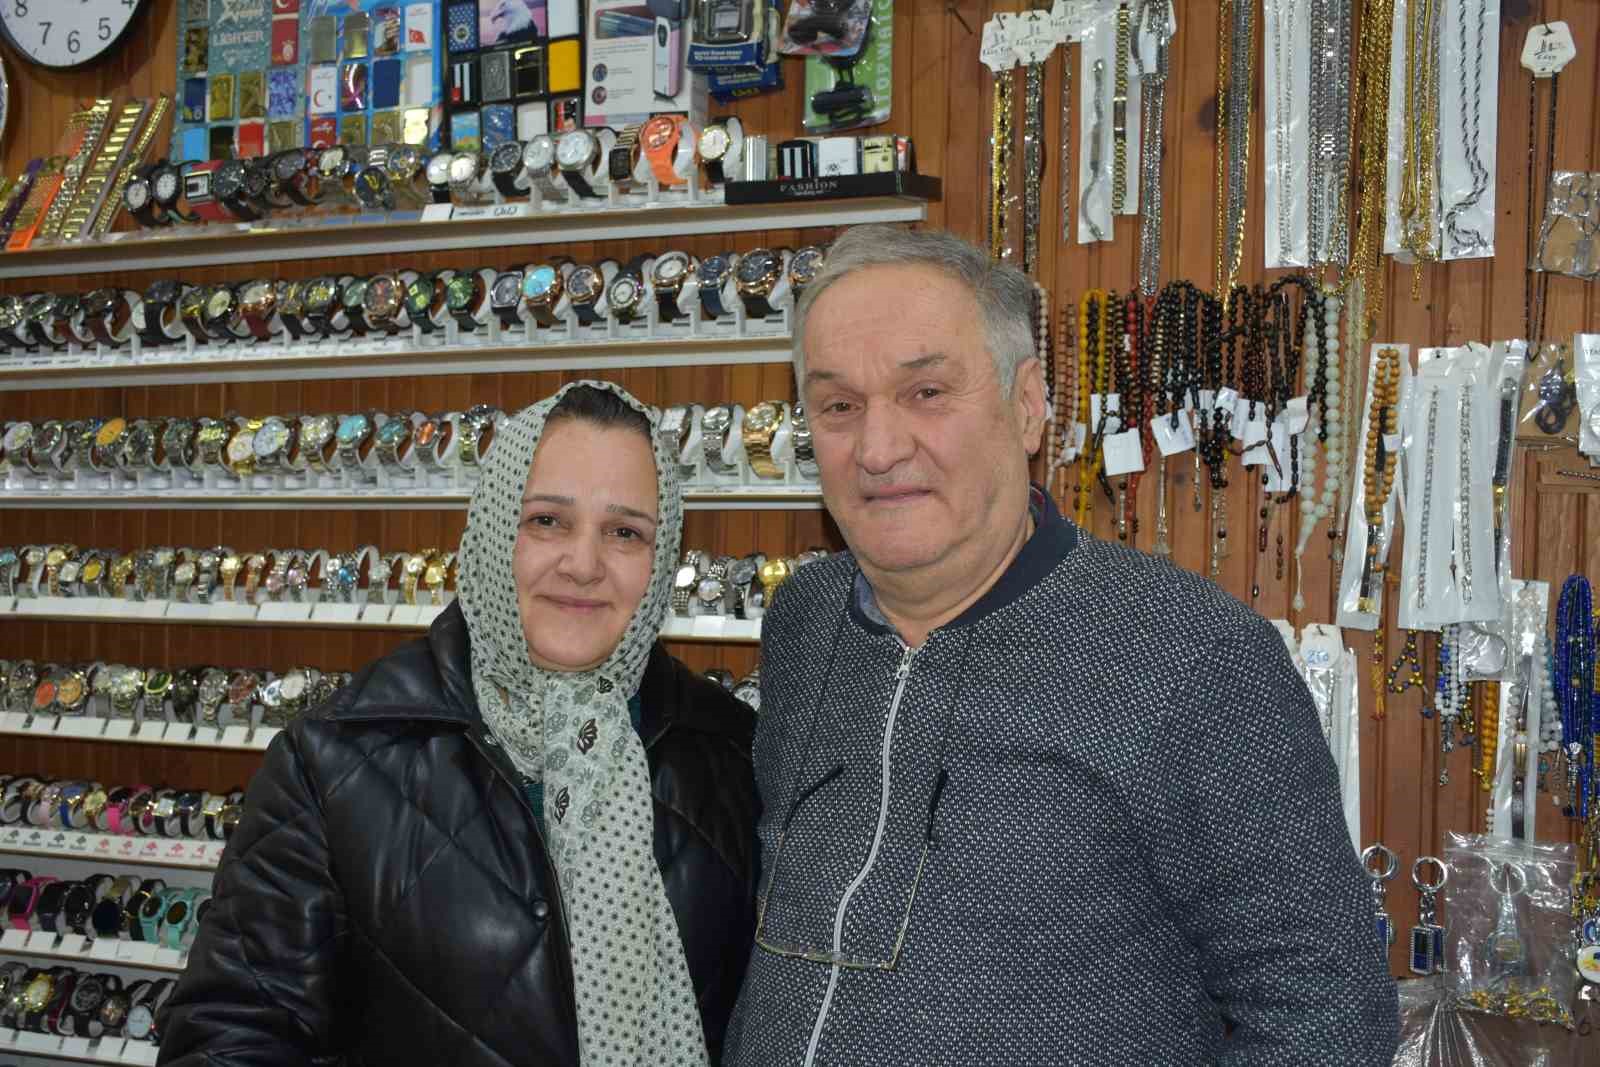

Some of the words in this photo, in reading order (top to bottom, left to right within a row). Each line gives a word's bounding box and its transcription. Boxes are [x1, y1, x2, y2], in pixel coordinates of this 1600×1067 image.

[15, 0, 28, 18] 8
[38, 21, 52, 46] 7
[97, 17, 112, 41] 5
[67, 30, 81, 54] 6
